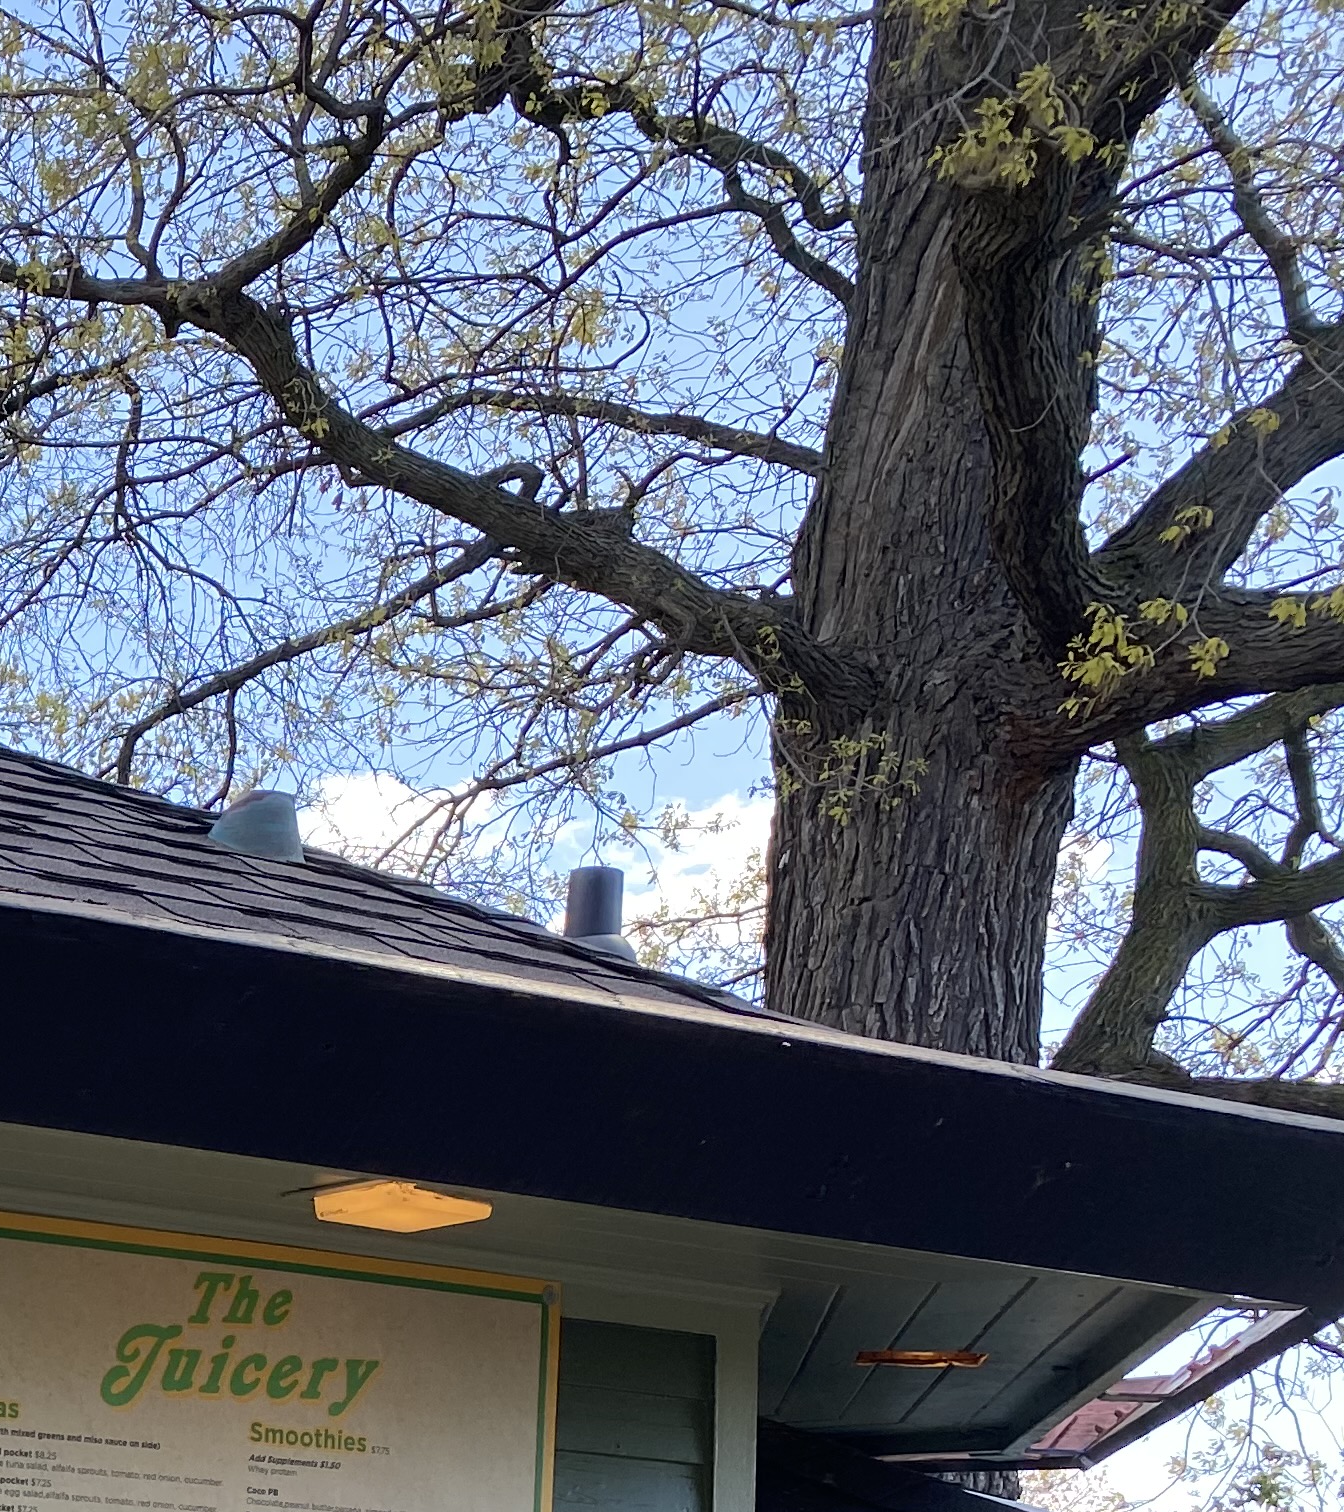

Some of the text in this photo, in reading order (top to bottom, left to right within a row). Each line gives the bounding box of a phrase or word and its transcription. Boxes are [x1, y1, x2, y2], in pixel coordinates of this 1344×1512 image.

[188, 1272, 293, 1326] The
[100, 1323, 380, 1417] Juicery
[249, 1421, 367, 1453] Smoothies
